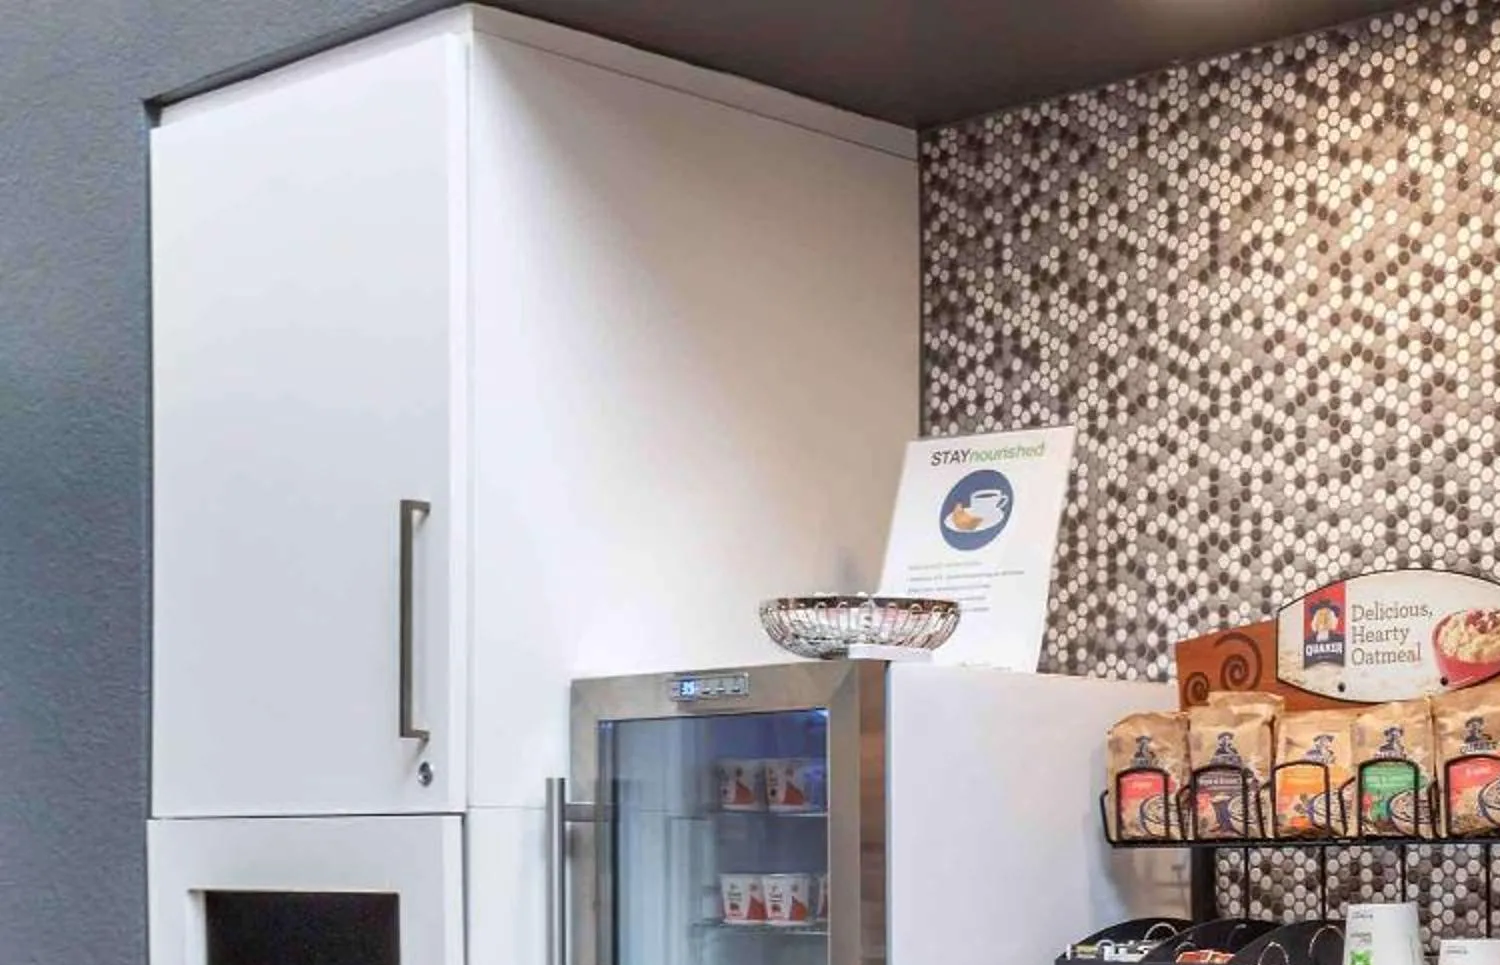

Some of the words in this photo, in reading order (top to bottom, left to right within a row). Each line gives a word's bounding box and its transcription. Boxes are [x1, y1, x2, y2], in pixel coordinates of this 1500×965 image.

[1350, 601, 1433, 623] Delicious,
[1350, 626, 1410, 645] Hearty
[1350, 643, 1422, 666] Oatmeal
